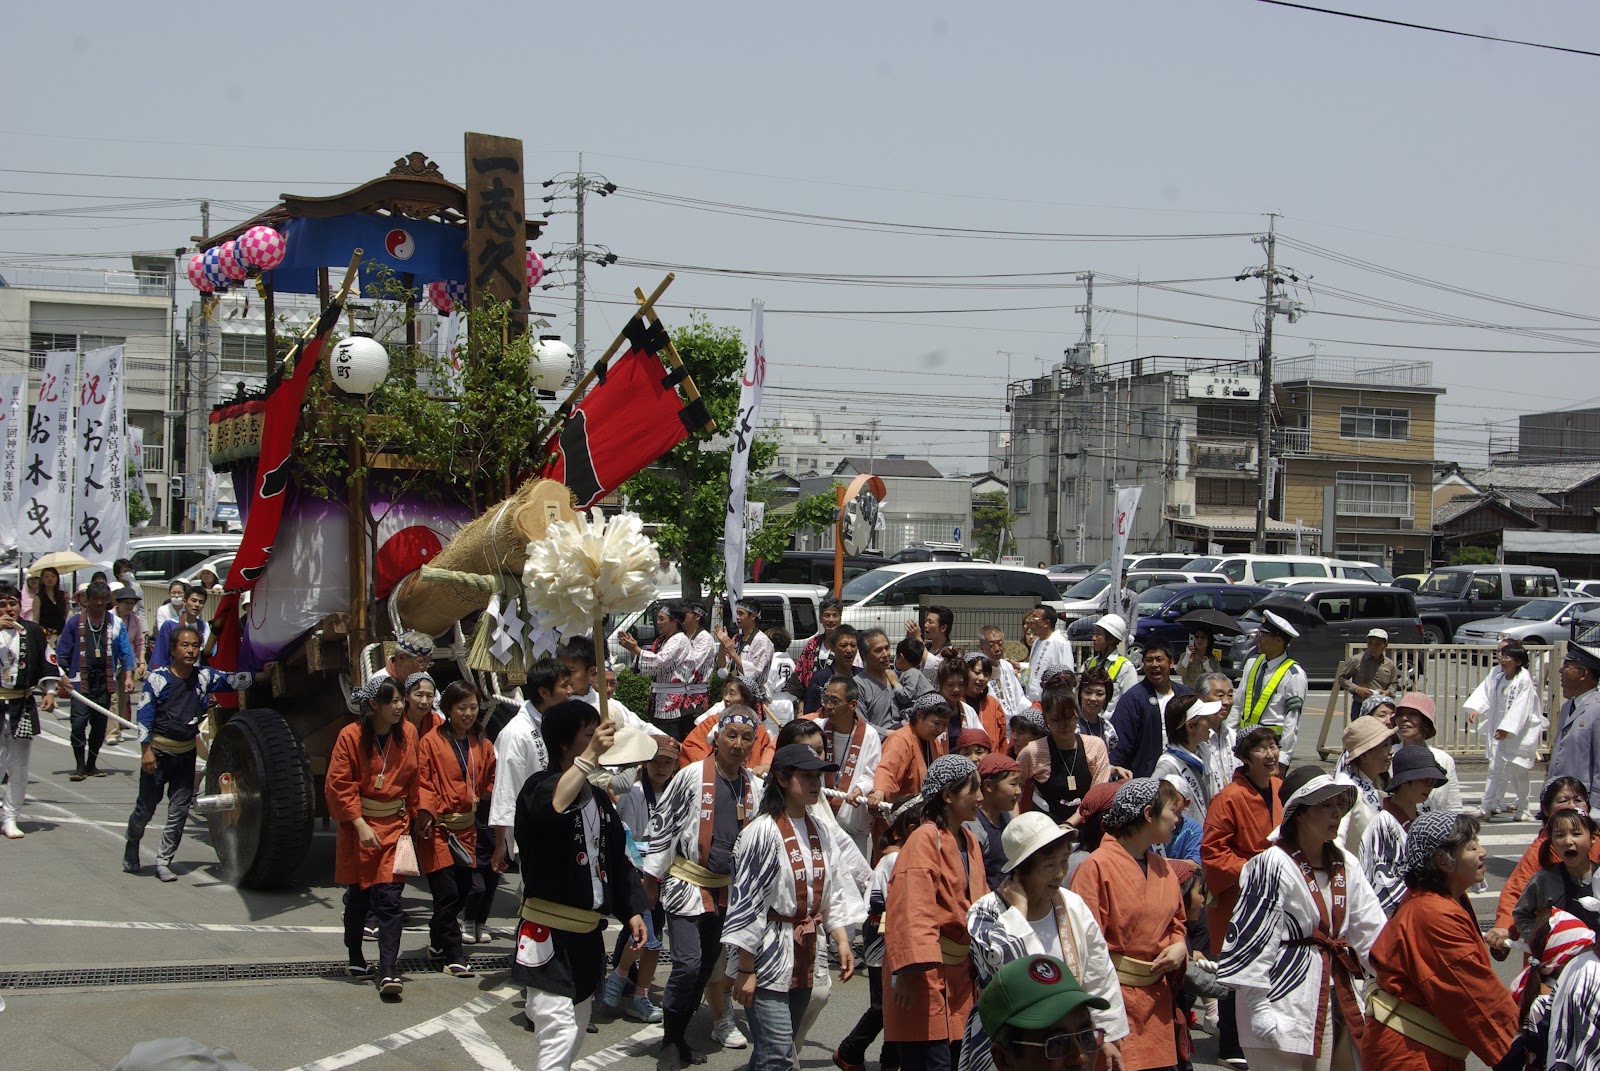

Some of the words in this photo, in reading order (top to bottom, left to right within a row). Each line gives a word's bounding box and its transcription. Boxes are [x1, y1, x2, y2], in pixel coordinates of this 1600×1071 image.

[336, 342, 354, 379] 一志町
[843, 744, 861, 778] 一志町
[701, 782, 714, 821] 一志町
[784, 835, 806, 881] 一志町
[809, 835, 825, 880] 一志町
[1291, 849, 1319, 893] 一志町
[1332, 861, 1346, 908] 一志町
